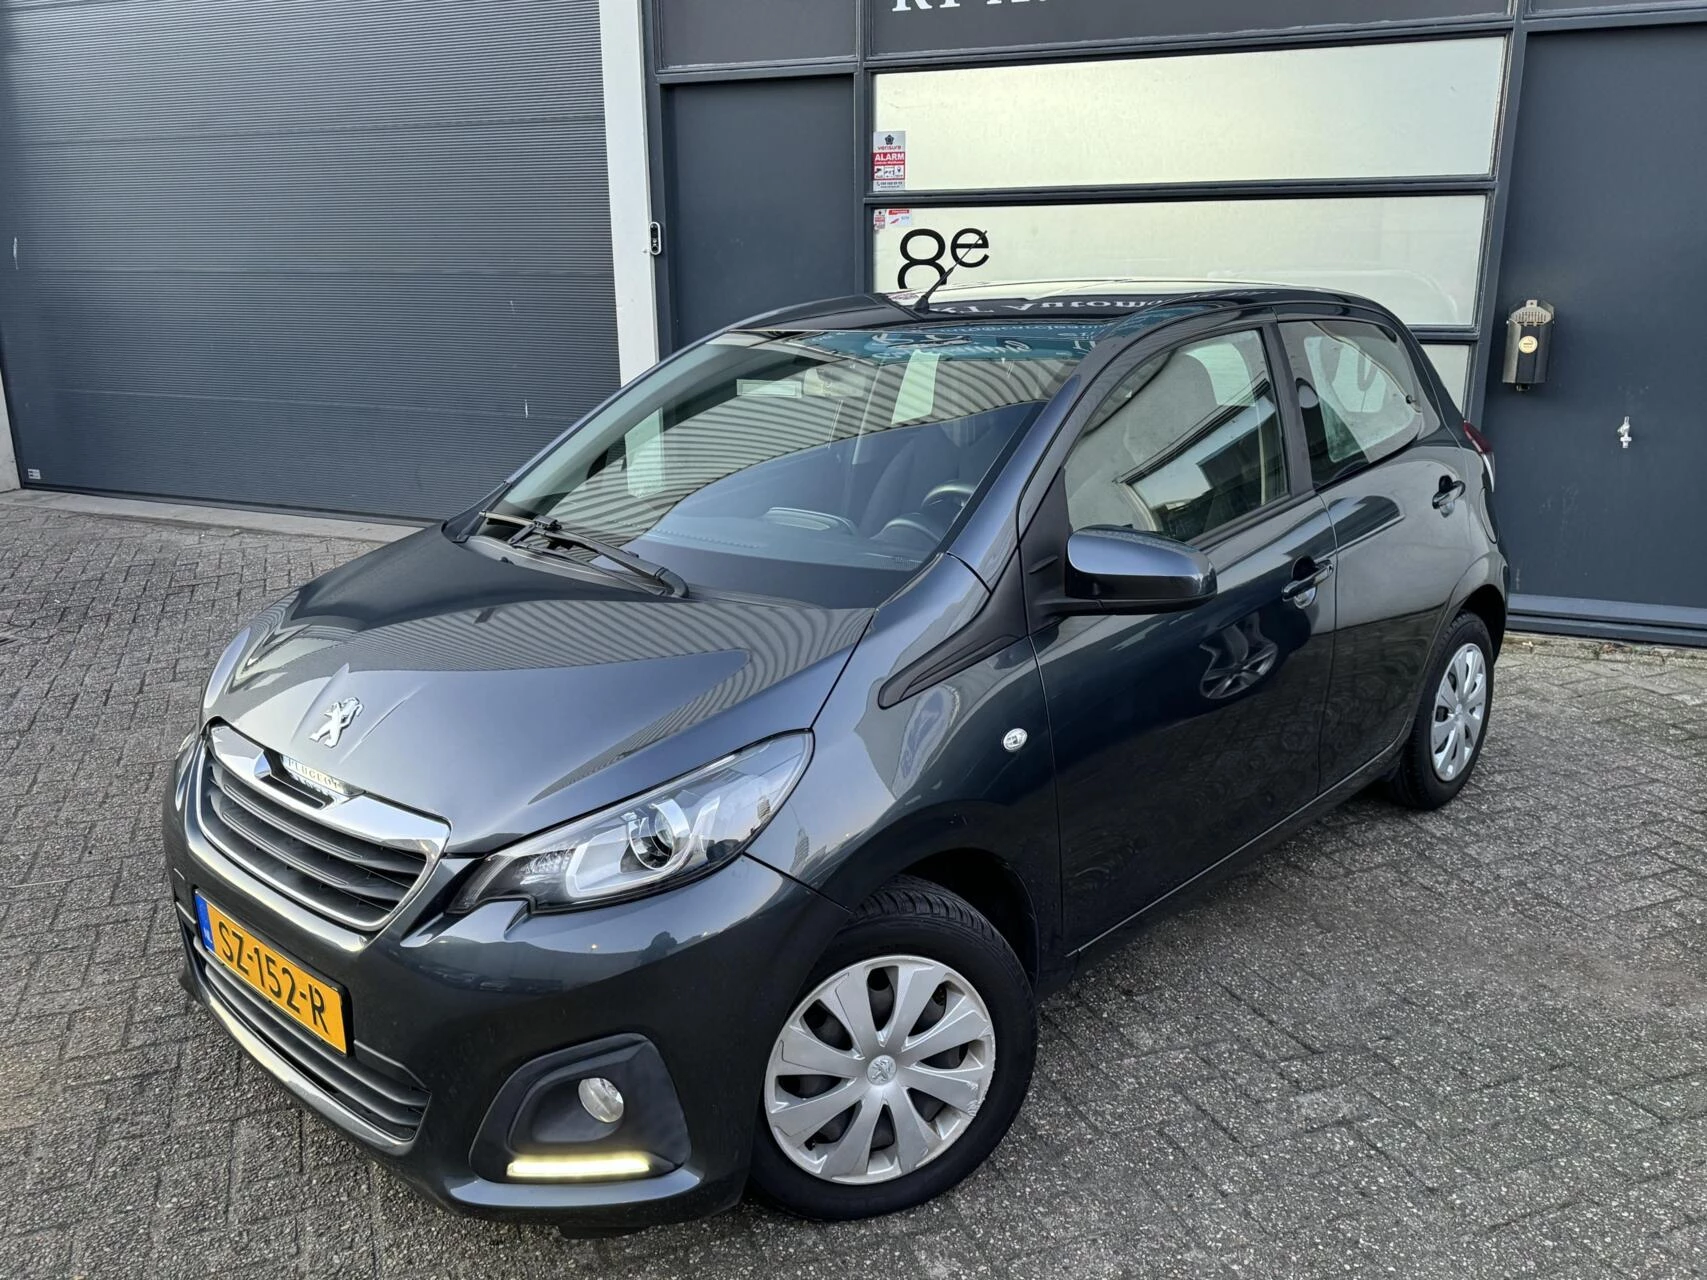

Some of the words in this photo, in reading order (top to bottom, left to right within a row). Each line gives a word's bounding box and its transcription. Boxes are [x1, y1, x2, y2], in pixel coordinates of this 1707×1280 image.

[874, 153, 905, 161] ALARM
[897, 228, 990, 289] 8e
[218, 920, 330, 1034] SZ-152-R
